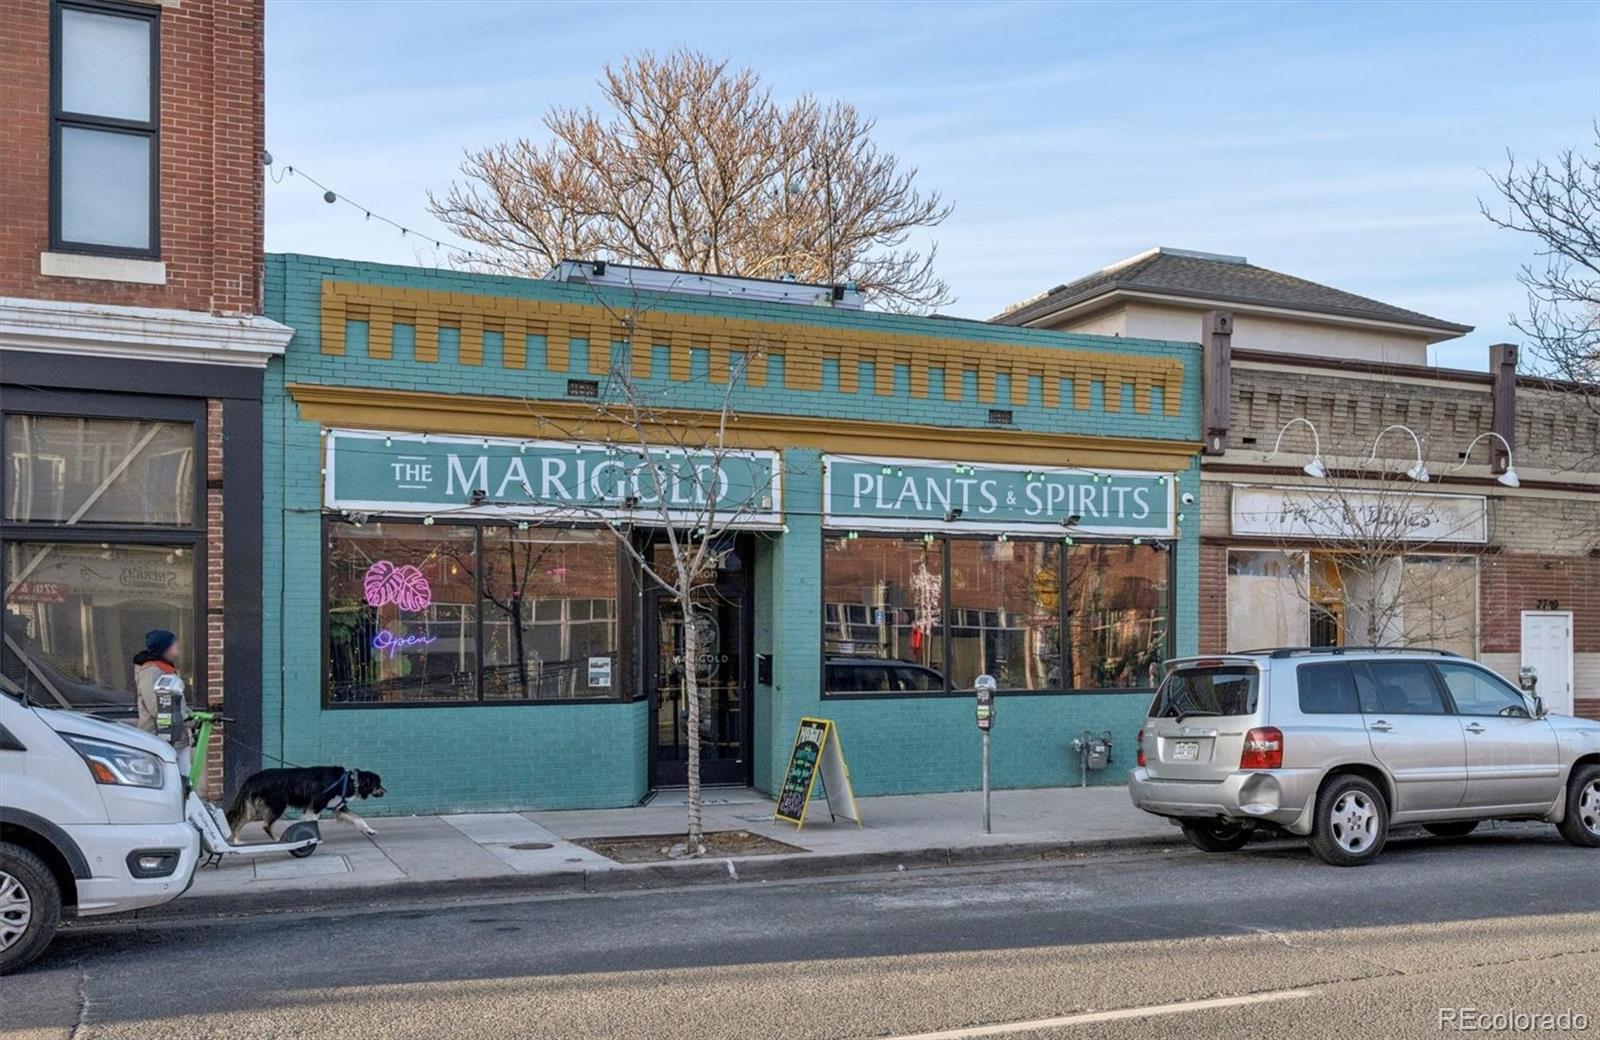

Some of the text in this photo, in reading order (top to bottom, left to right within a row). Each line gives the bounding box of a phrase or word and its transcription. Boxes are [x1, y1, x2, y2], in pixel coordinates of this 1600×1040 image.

[390, 453, 729, 503] THE MARIGOLD
[853, 473, 1150, 519] PLANTS & SPIRITS
[373, 630, 437, 659] Open
